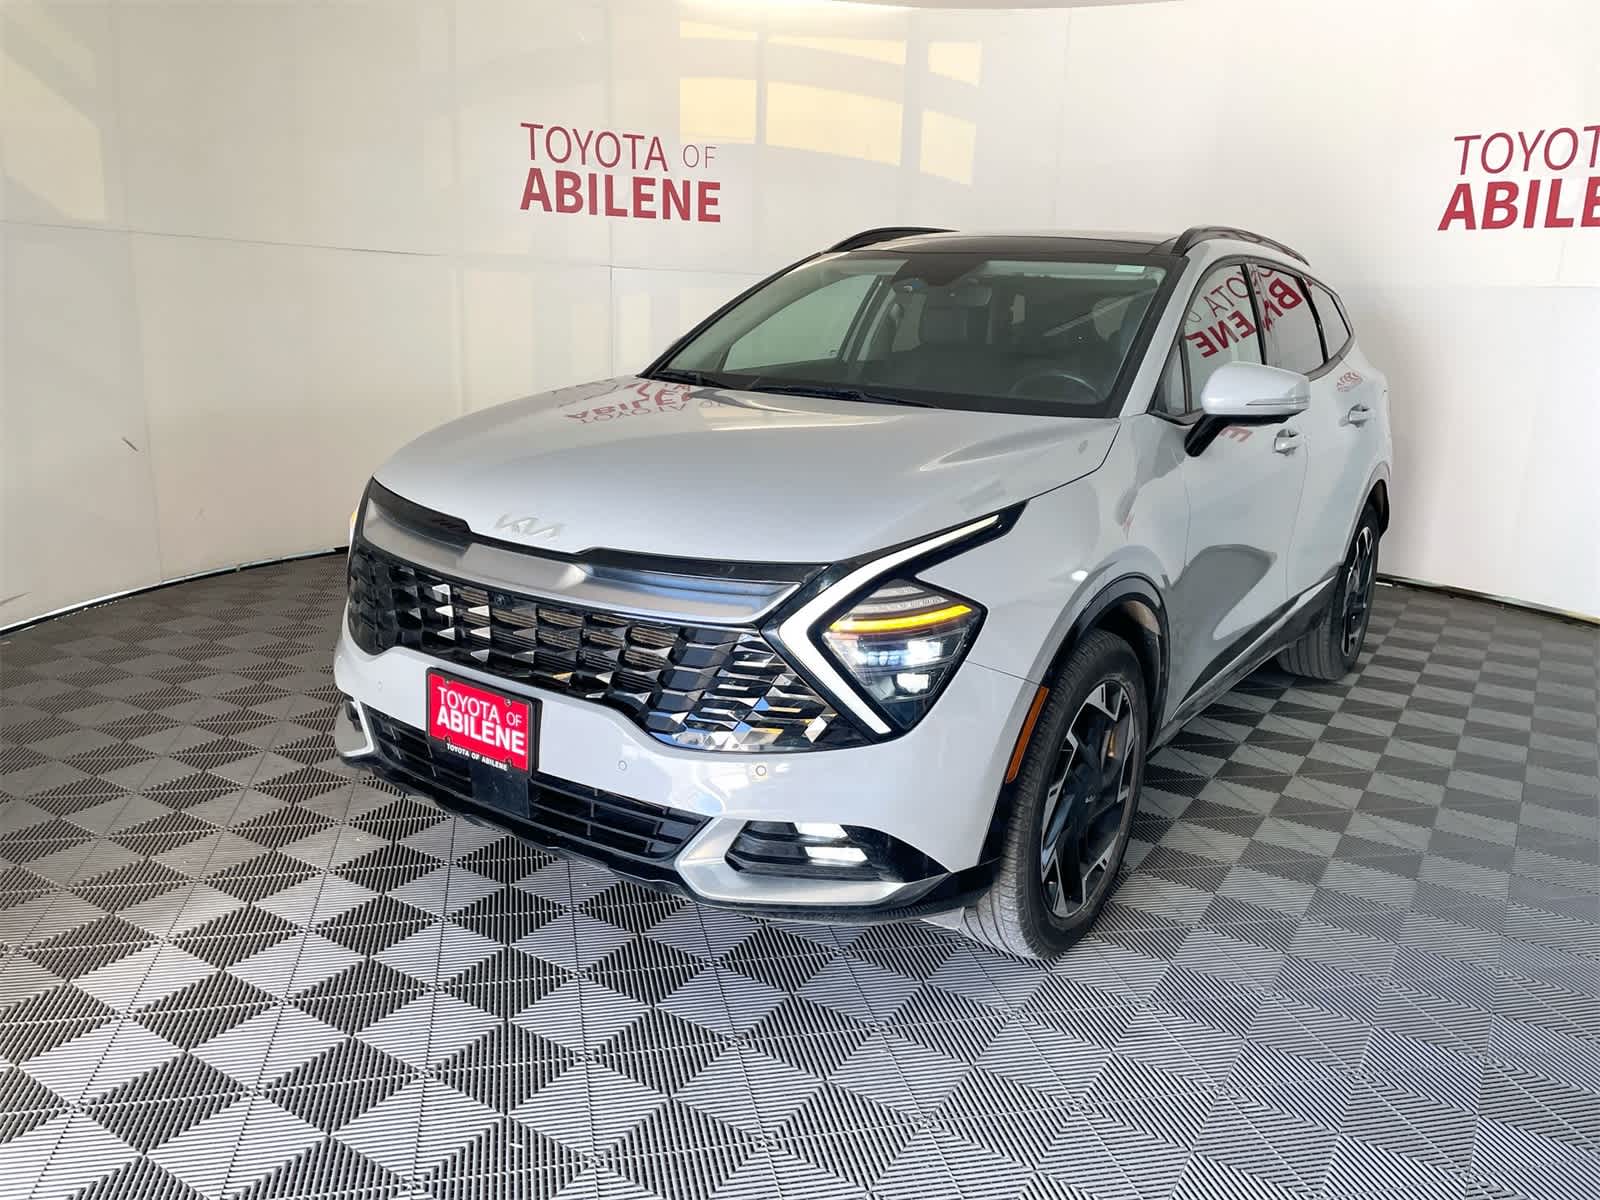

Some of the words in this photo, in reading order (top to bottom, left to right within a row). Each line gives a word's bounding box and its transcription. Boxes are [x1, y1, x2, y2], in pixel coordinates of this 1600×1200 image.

[520, 122, 669, 172] TOYOTA
[682, 144, 717, 169] OF
[1454, 125, 1600, 176] TOYOT
[520, 167, 721, 223] ABILENE
[1437, 176, 1600, 231] ABILE
[436, 705, 525, 756] ABILENE
[437, 685, 501, 724] TOYOTA
[506, 711, 522, 727] OF
[446, 743, 470, 757] TOYOTA
[471, 752, 480, 760] OF
[481, 756, 508, 772] ABILENE
